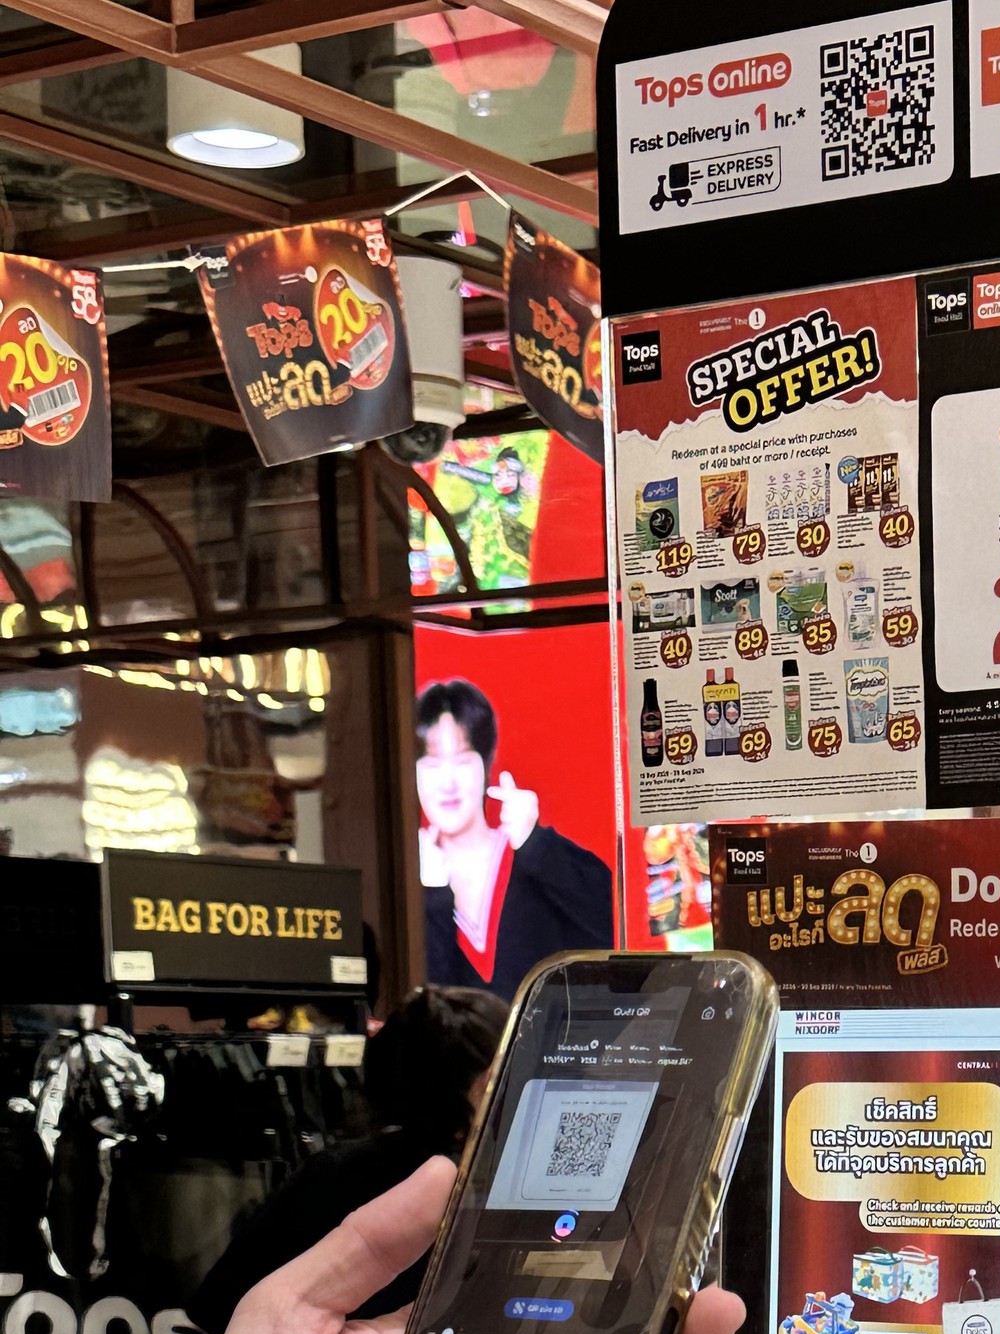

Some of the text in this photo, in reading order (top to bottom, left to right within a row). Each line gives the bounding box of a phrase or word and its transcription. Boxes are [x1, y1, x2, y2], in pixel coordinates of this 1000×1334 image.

[635, 59, 787, 107] Tops online
[630, 131, 663, 154] Fast
[667, 124, 731, 151] Delivery
[735, 119, 750, 138] in
[755, 104, 768, 131] 1
[707, 154, 773, 177] EXPRESS
[707, 172, 773, 195] DELIVERY
[928, 292, 967, 311] Tops
[246, 320, 313, 358] Tops
[624, 343, 658, 361] Tops
[692, 317, 836, 398] SPECIAL
[729, 337, 874, 426] OFFER!
[672, 448, 708, 459] Redeem
[729, 439, 760, 455] special
[763, 438, 786, 450] price
[788, 433, 807, 444] with
[810, 428, 857, 443] purchases
[700, 460, 708, 470] of
[730, 454, 750, 467] baht
[752, 455, 761, 463] or
[765, 452, 788, 462] more
[796, 445, 831, 458] receipt
[715, 590, 738, 603] Scott
[729, 849, 765, 866] Tops
[133, 897, 343, 940] BAG FOR LIFE
[795, 1012, 840, 1021] WINCOR
[795, 1025, 840, 1035] NIXDORF
[811, 1126, 992, 1152] และรับของสมนาคุณ
[867, 1199, 899, 1211] Check
[900, 1201, 920, 1212] and
[922, 1202, 956, 1212] receive
[957, 1203, 996, 1213] rewards
[867, 1214, 884, 1226] the
[885, 1215, 930, 1227] customer
[932, 1217, 965, 1228] service
